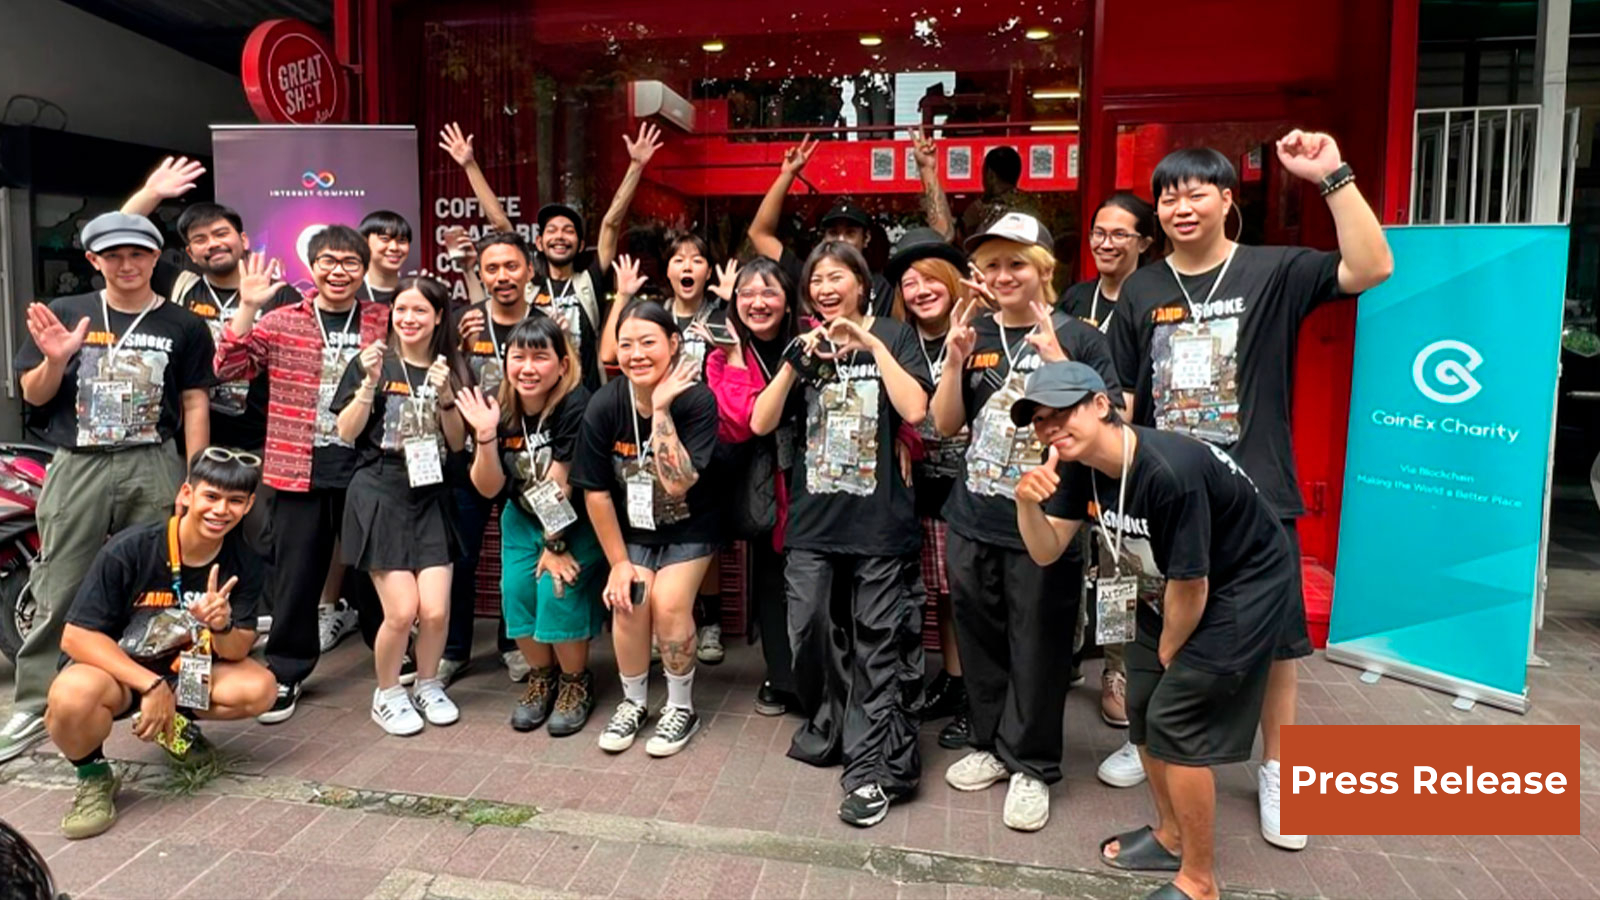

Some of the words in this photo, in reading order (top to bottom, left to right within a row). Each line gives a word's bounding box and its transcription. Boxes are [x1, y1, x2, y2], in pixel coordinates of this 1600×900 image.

[278, 54, 322, 91] GREAT
[269, 189, 314, 197] INTERNET
[317, 189, 365, 197] COMPUTER
[1192, 297, 1246, 319] SMOKE
[124, 333, 174, 352] SMOKE
[1371, 409, 1436, 431] CoinEx
[1440, 417, 1520, 444] Charity
[1399, 463, 1417, 475] Via
[1419, 466, 1475, 483] Blockchain
[1356, 474, 1392, 489] Making
[1394, 479, 1411, 491] the
[1414, 483, 1445, 495] World
[1455, 489, 1488, 503] Better
[1491, 495, 1523, 508] Place
